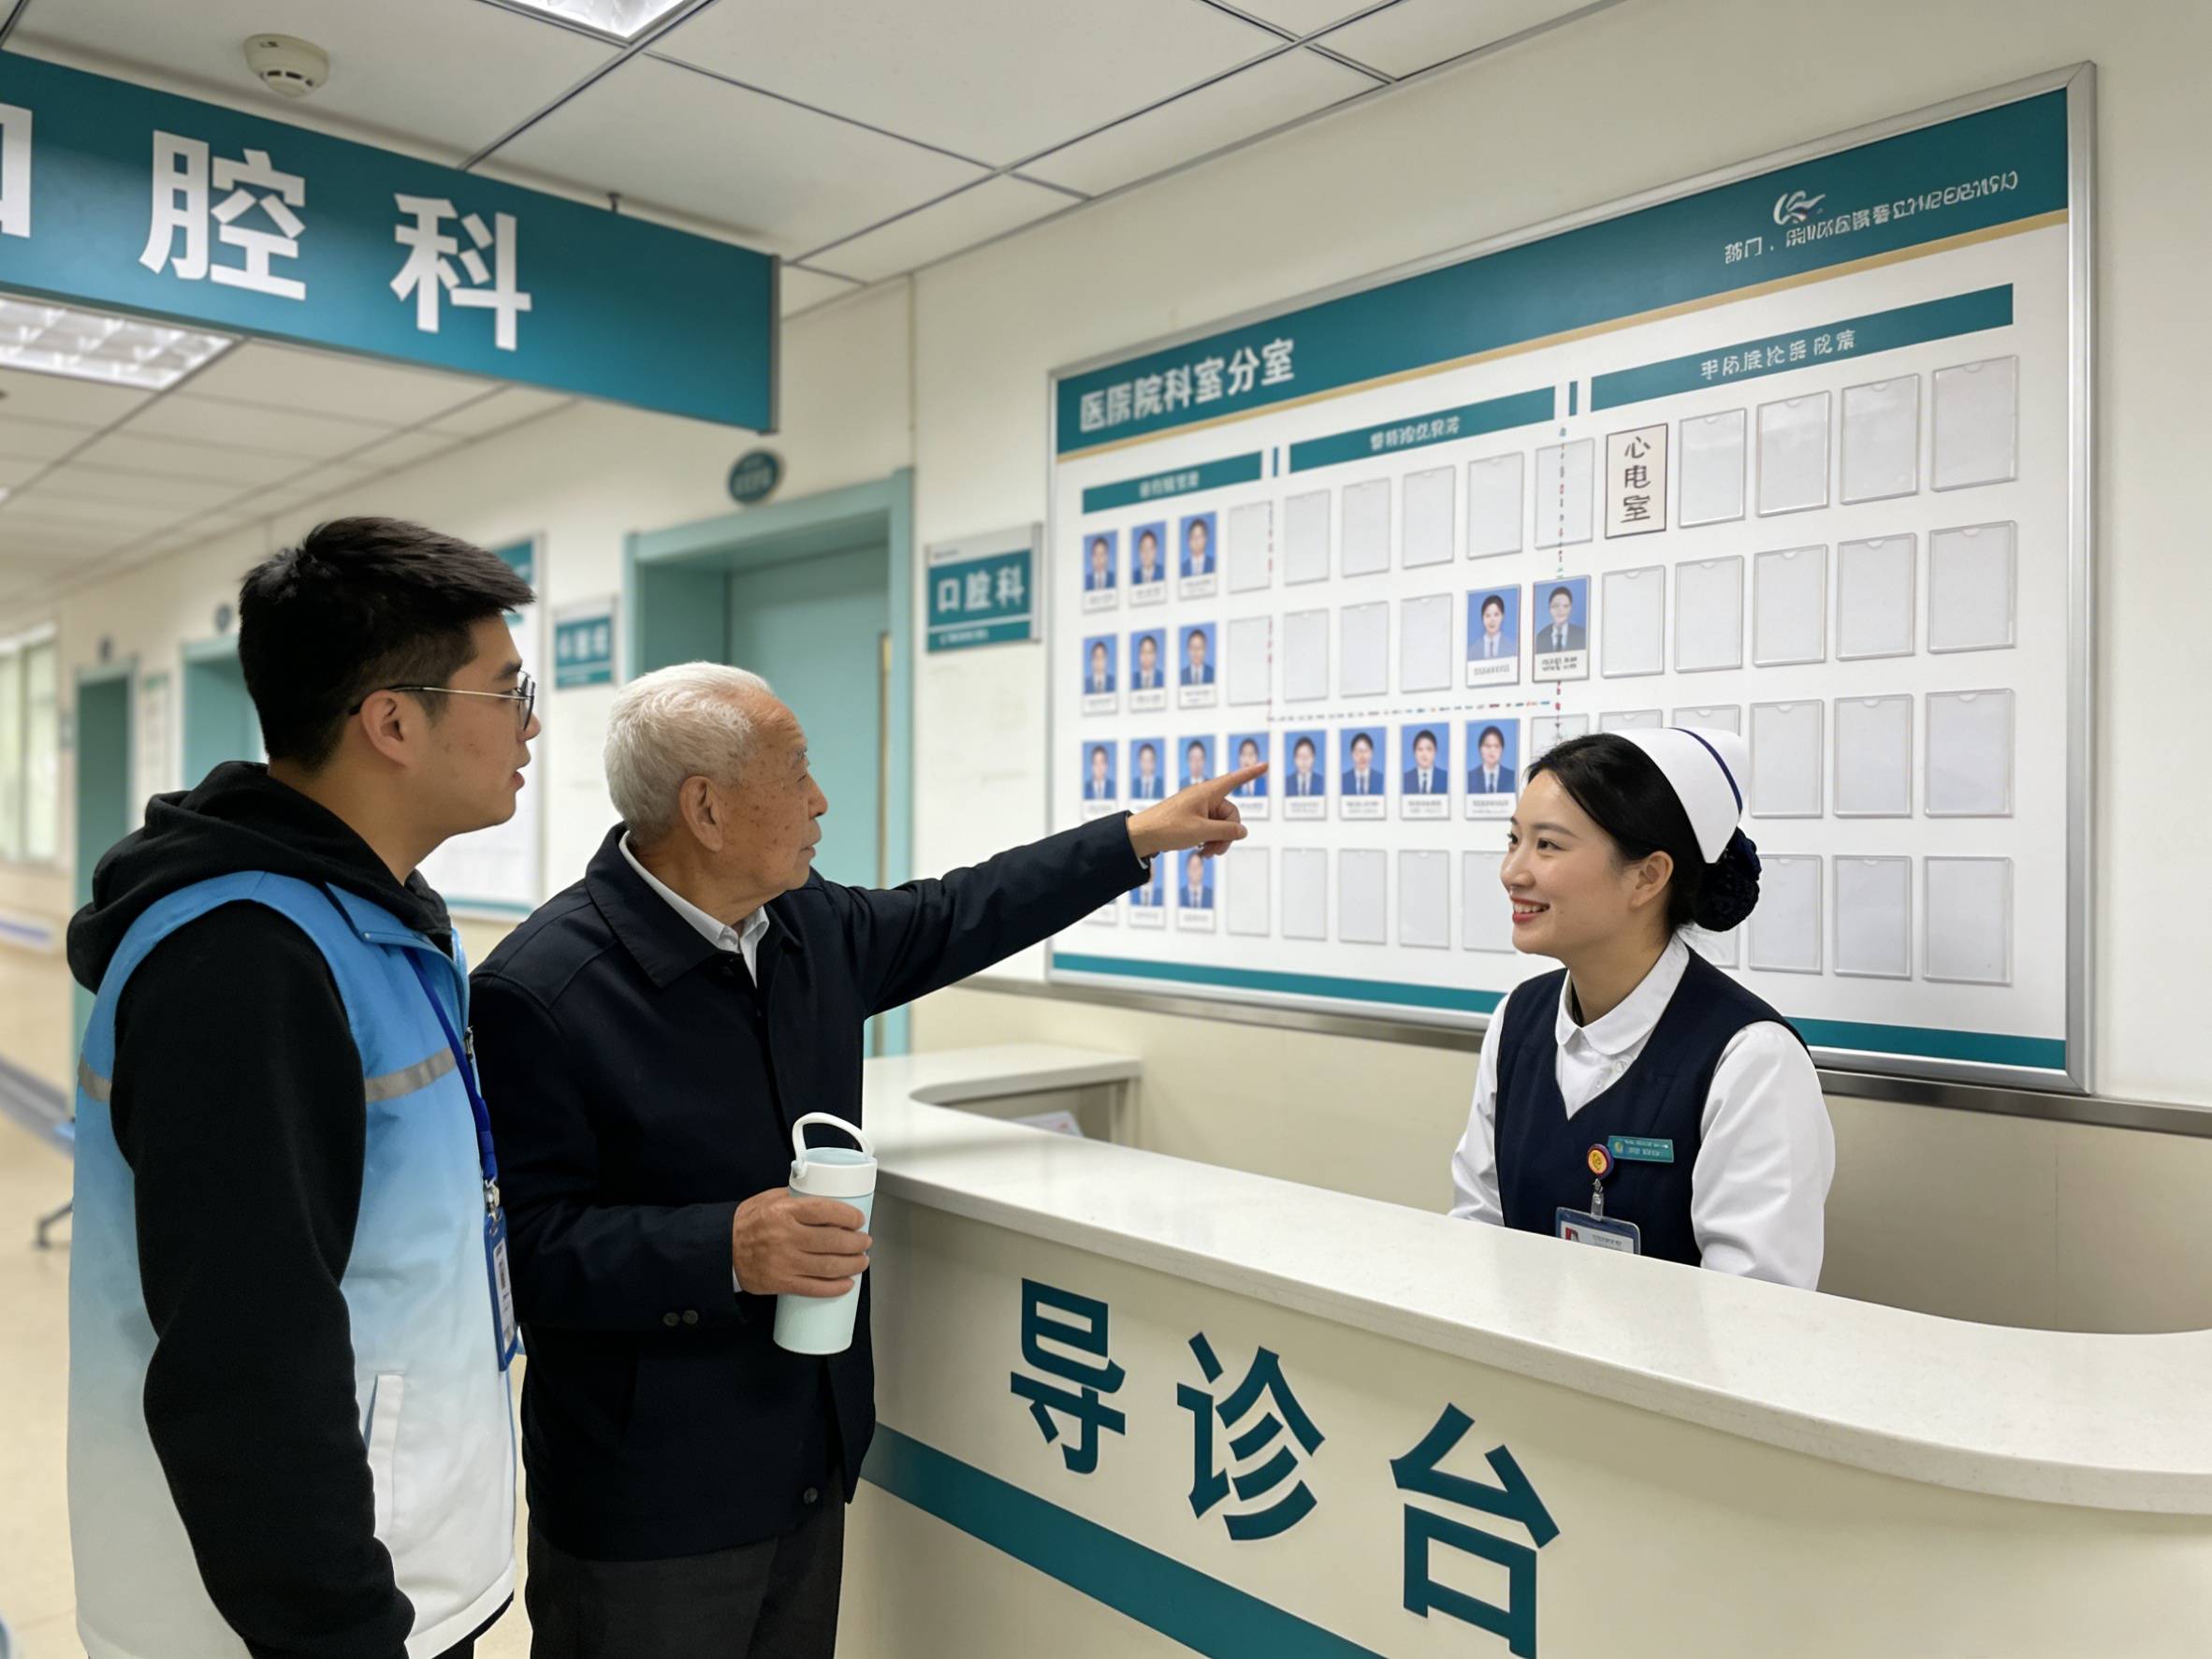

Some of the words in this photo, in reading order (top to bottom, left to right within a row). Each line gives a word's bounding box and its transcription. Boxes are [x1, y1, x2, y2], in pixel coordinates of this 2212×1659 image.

[1621, 435, 1652, 524] 心电室
[937, 564, 1026, 614] 口腔科
[1010, 1277, 1561, 1659] 导诊台
